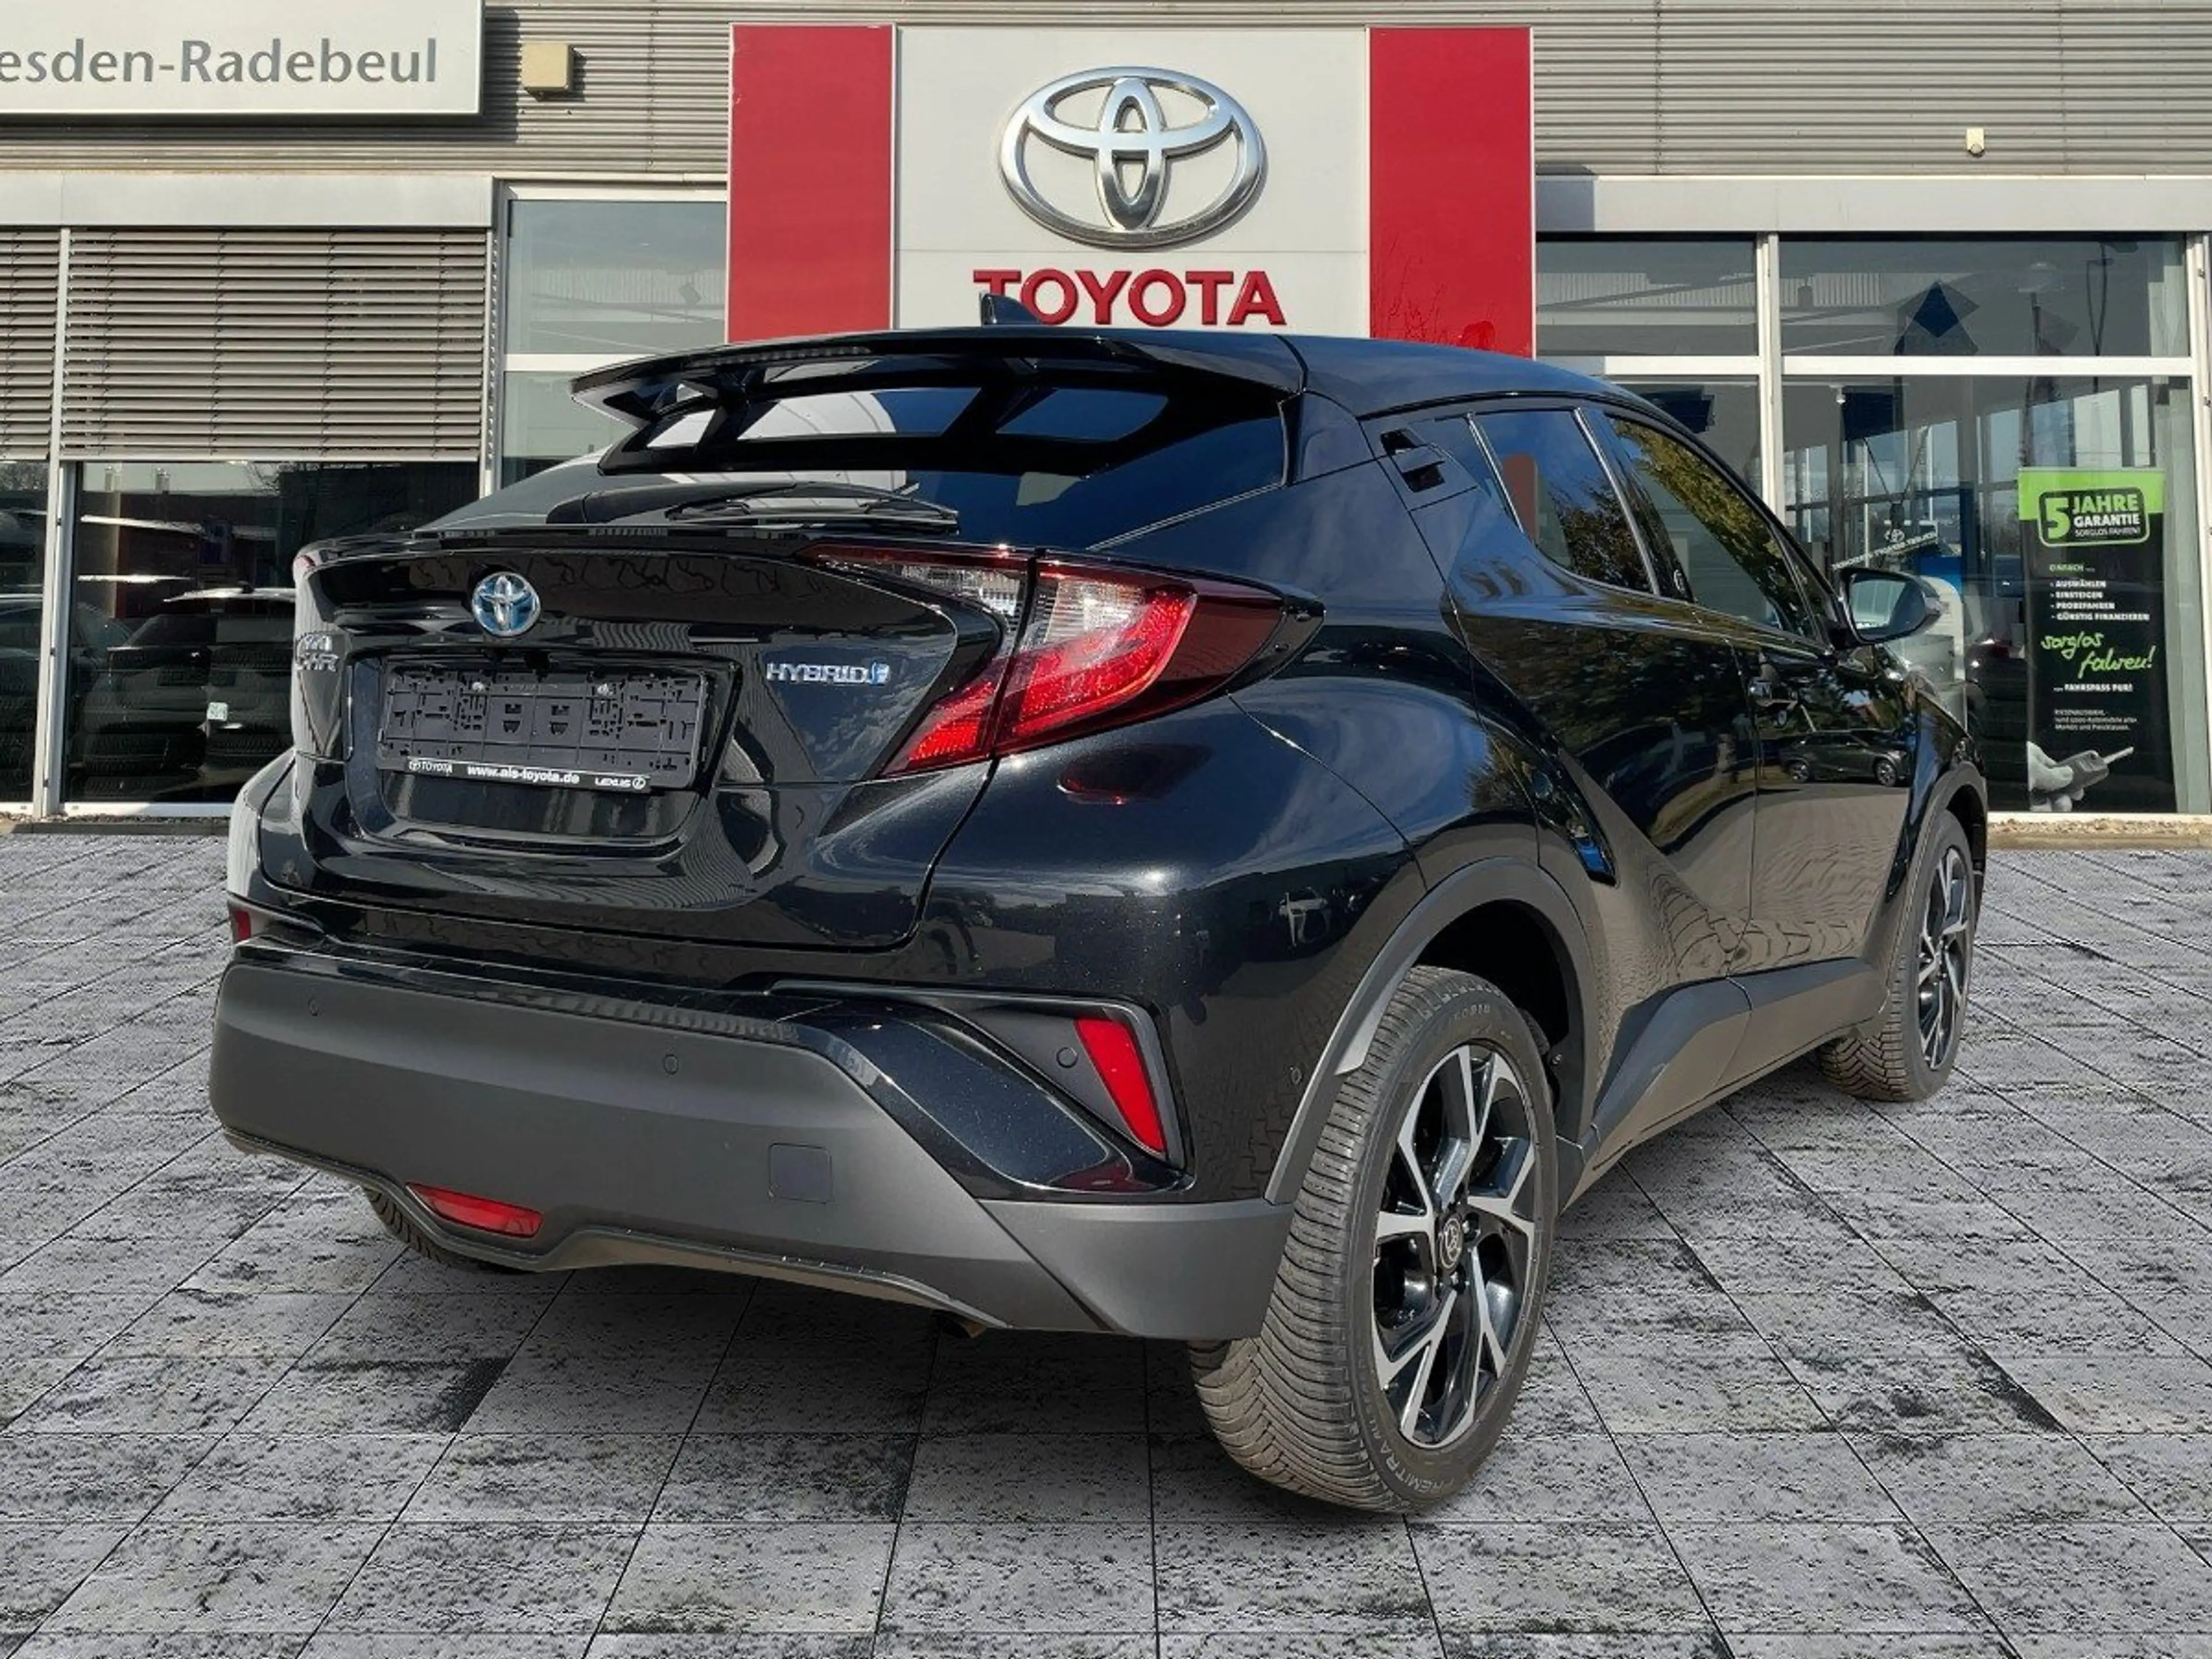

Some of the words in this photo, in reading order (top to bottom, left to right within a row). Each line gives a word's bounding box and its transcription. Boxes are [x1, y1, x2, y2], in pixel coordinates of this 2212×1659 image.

[974, 268, 1287, 327] TOYOTA
[2046, 498, 2070, 539] 5
[2073, 494, 2139, 514] JAHRE
[2074, 514, 2140, 528] GARANTIE
[2041, 631, 2104, 660] sorglos
[767, 662, 868, 683] HYBRID
